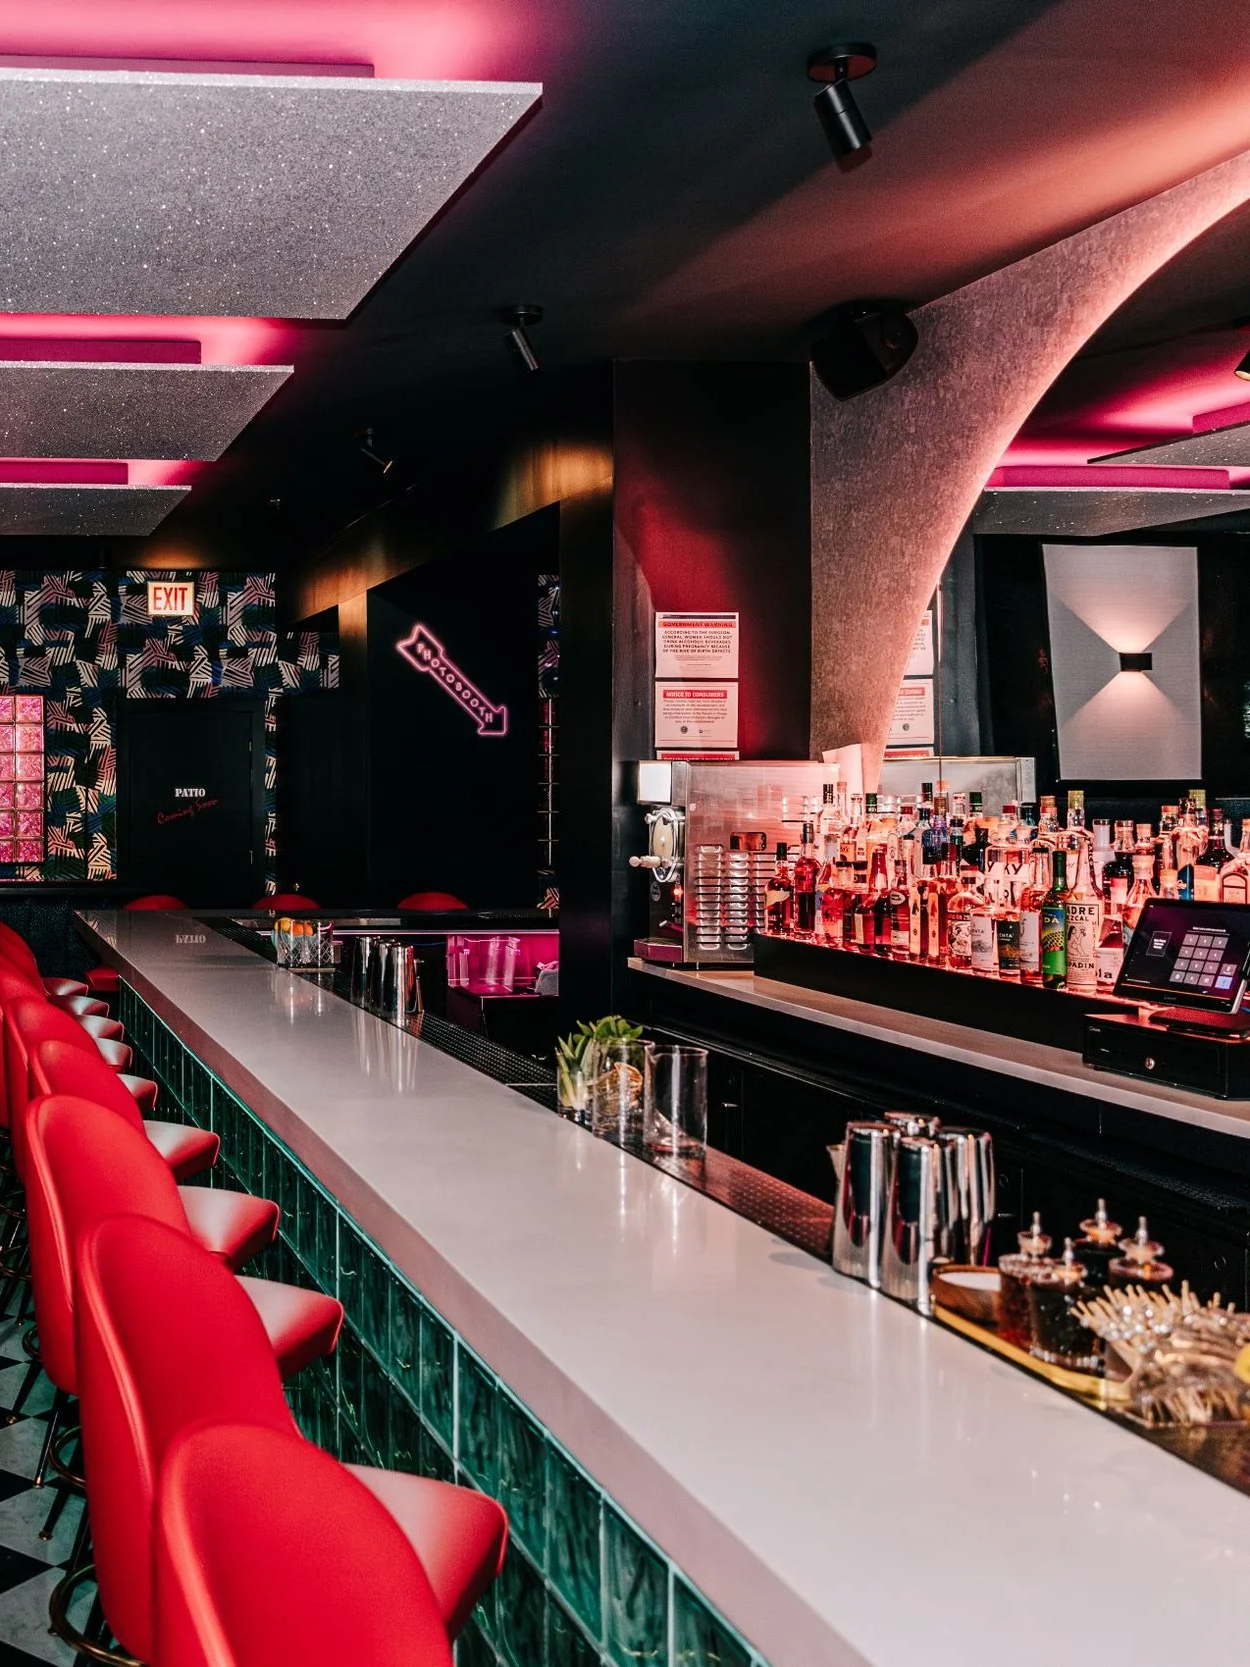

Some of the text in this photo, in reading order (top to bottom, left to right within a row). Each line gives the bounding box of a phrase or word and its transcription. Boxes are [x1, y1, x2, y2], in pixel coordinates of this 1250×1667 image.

[153, 587, 188, 611] EXIT
[416, 643, 493, 722] PHOTOBOOTH
[174, 788, 206, 798] PATIO
